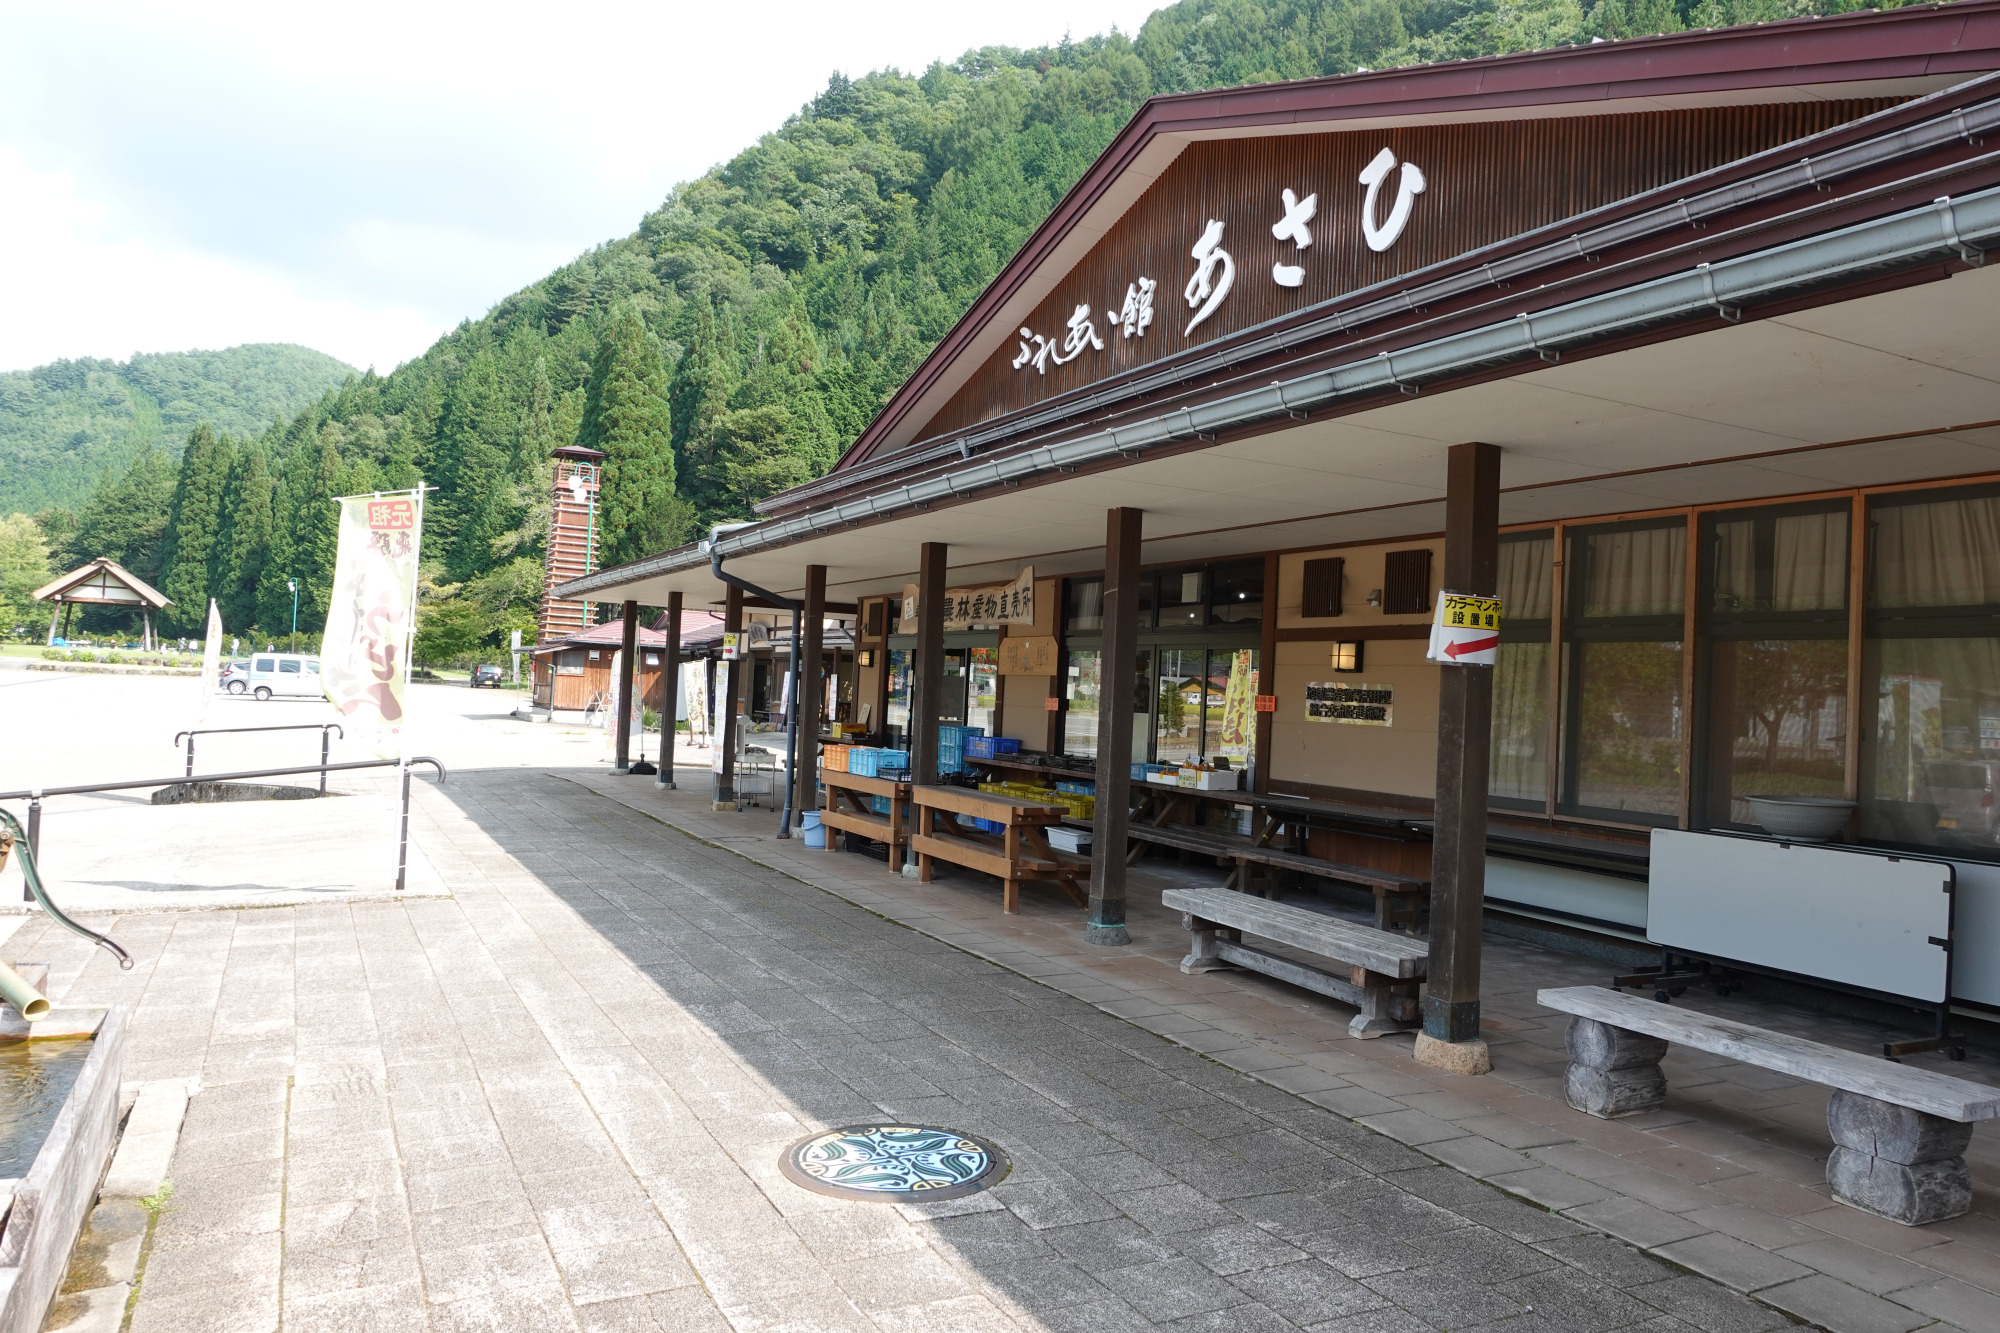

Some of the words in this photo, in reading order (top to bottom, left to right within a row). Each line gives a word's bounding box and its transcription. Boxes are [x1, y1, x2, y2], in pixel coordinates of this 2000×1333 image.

[1184, 146, 1427, 338] あさひ
[1452, 611, 1501, 628] 設置場
